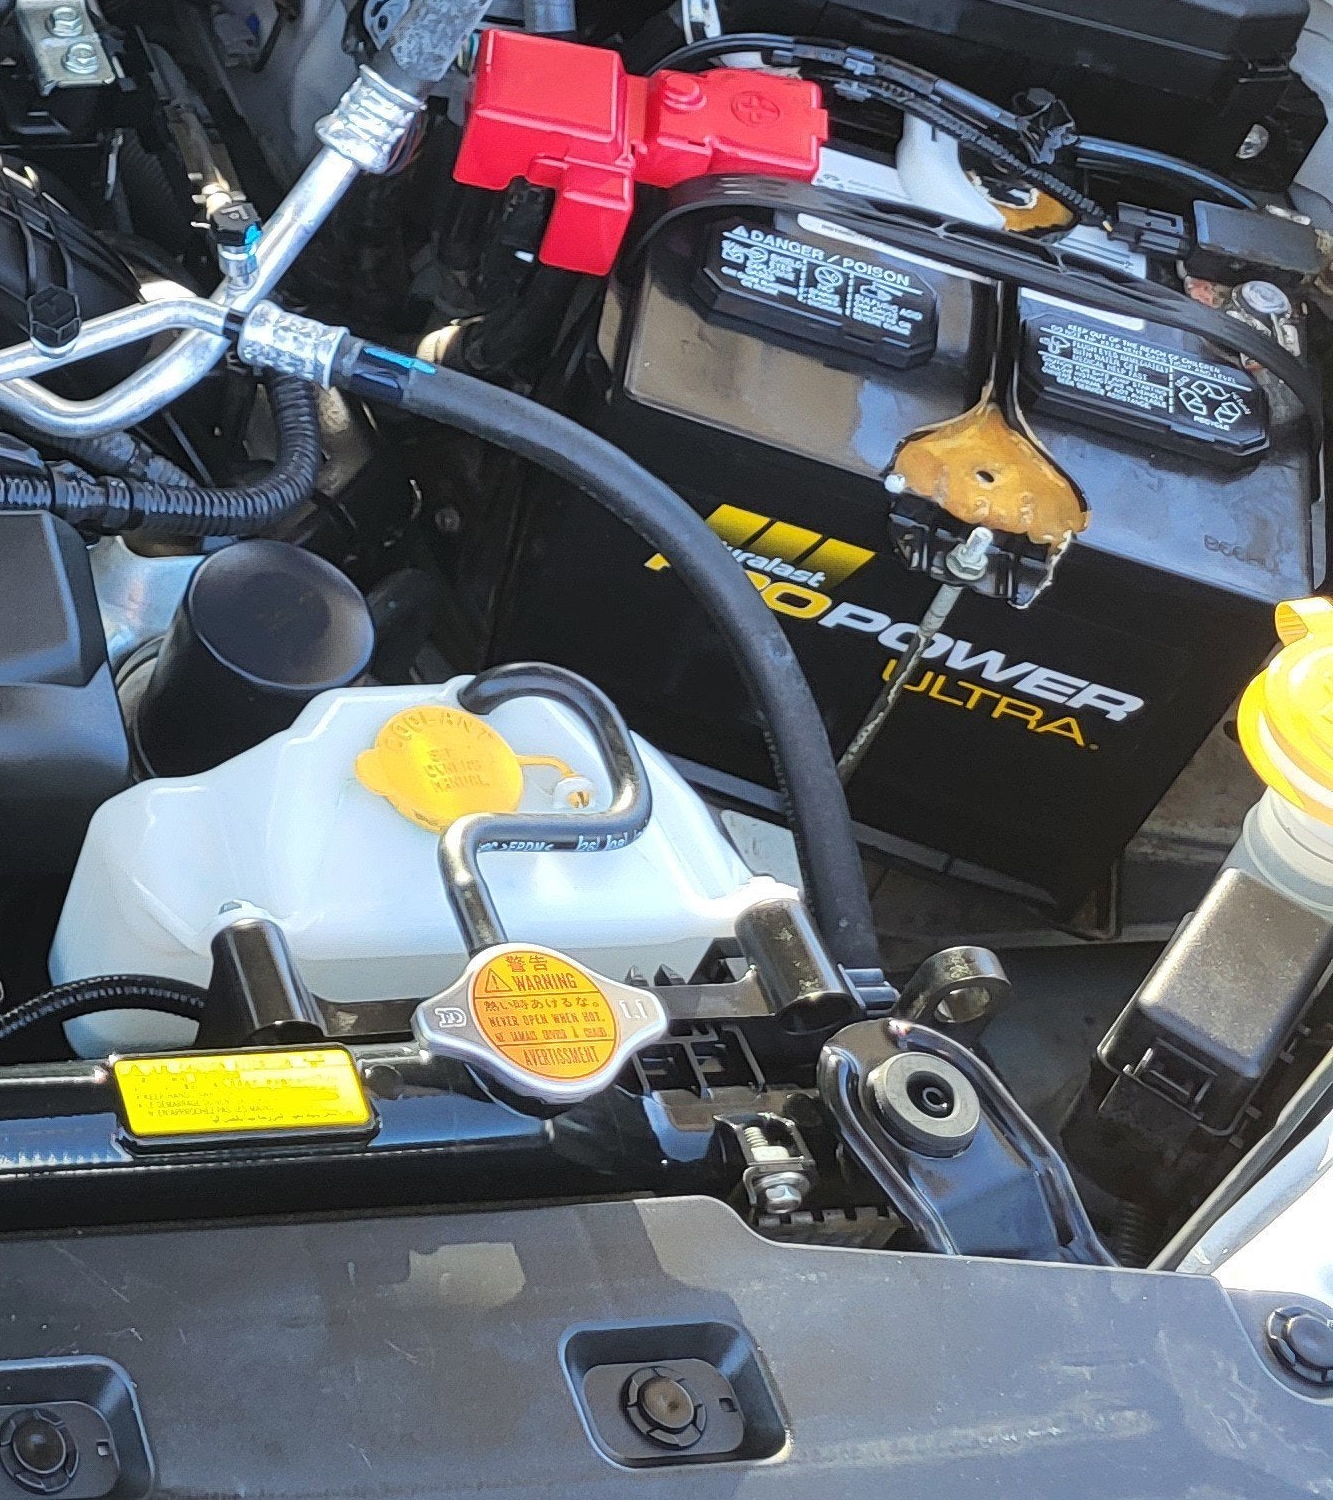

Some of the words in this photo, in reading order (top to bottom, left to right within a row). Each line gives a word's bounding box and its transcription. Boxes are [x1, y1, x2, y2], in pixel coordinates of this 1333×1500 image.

[750, 229, 825, 262] DANGER
[842, 256, 911, 287] POISON
[1089, 330, 1105, 340] OUT
[1109, 335, 1119, 343] OF
[1122, 339, 1137, 349] THE
[1139, 344, 1166, 357] REACH
[1181, 356, 1220, 373] CHILDREN
[722, 540, 826, 588] ralast
[506, 954, 547, 972] 警告
[511, 972, 578, 992] WARNING
[488, 1015, 519, 1028] NEVER
[522, 1013, 548, 1026] OPEN
[551, 1012, 580, 1024] WHEN
